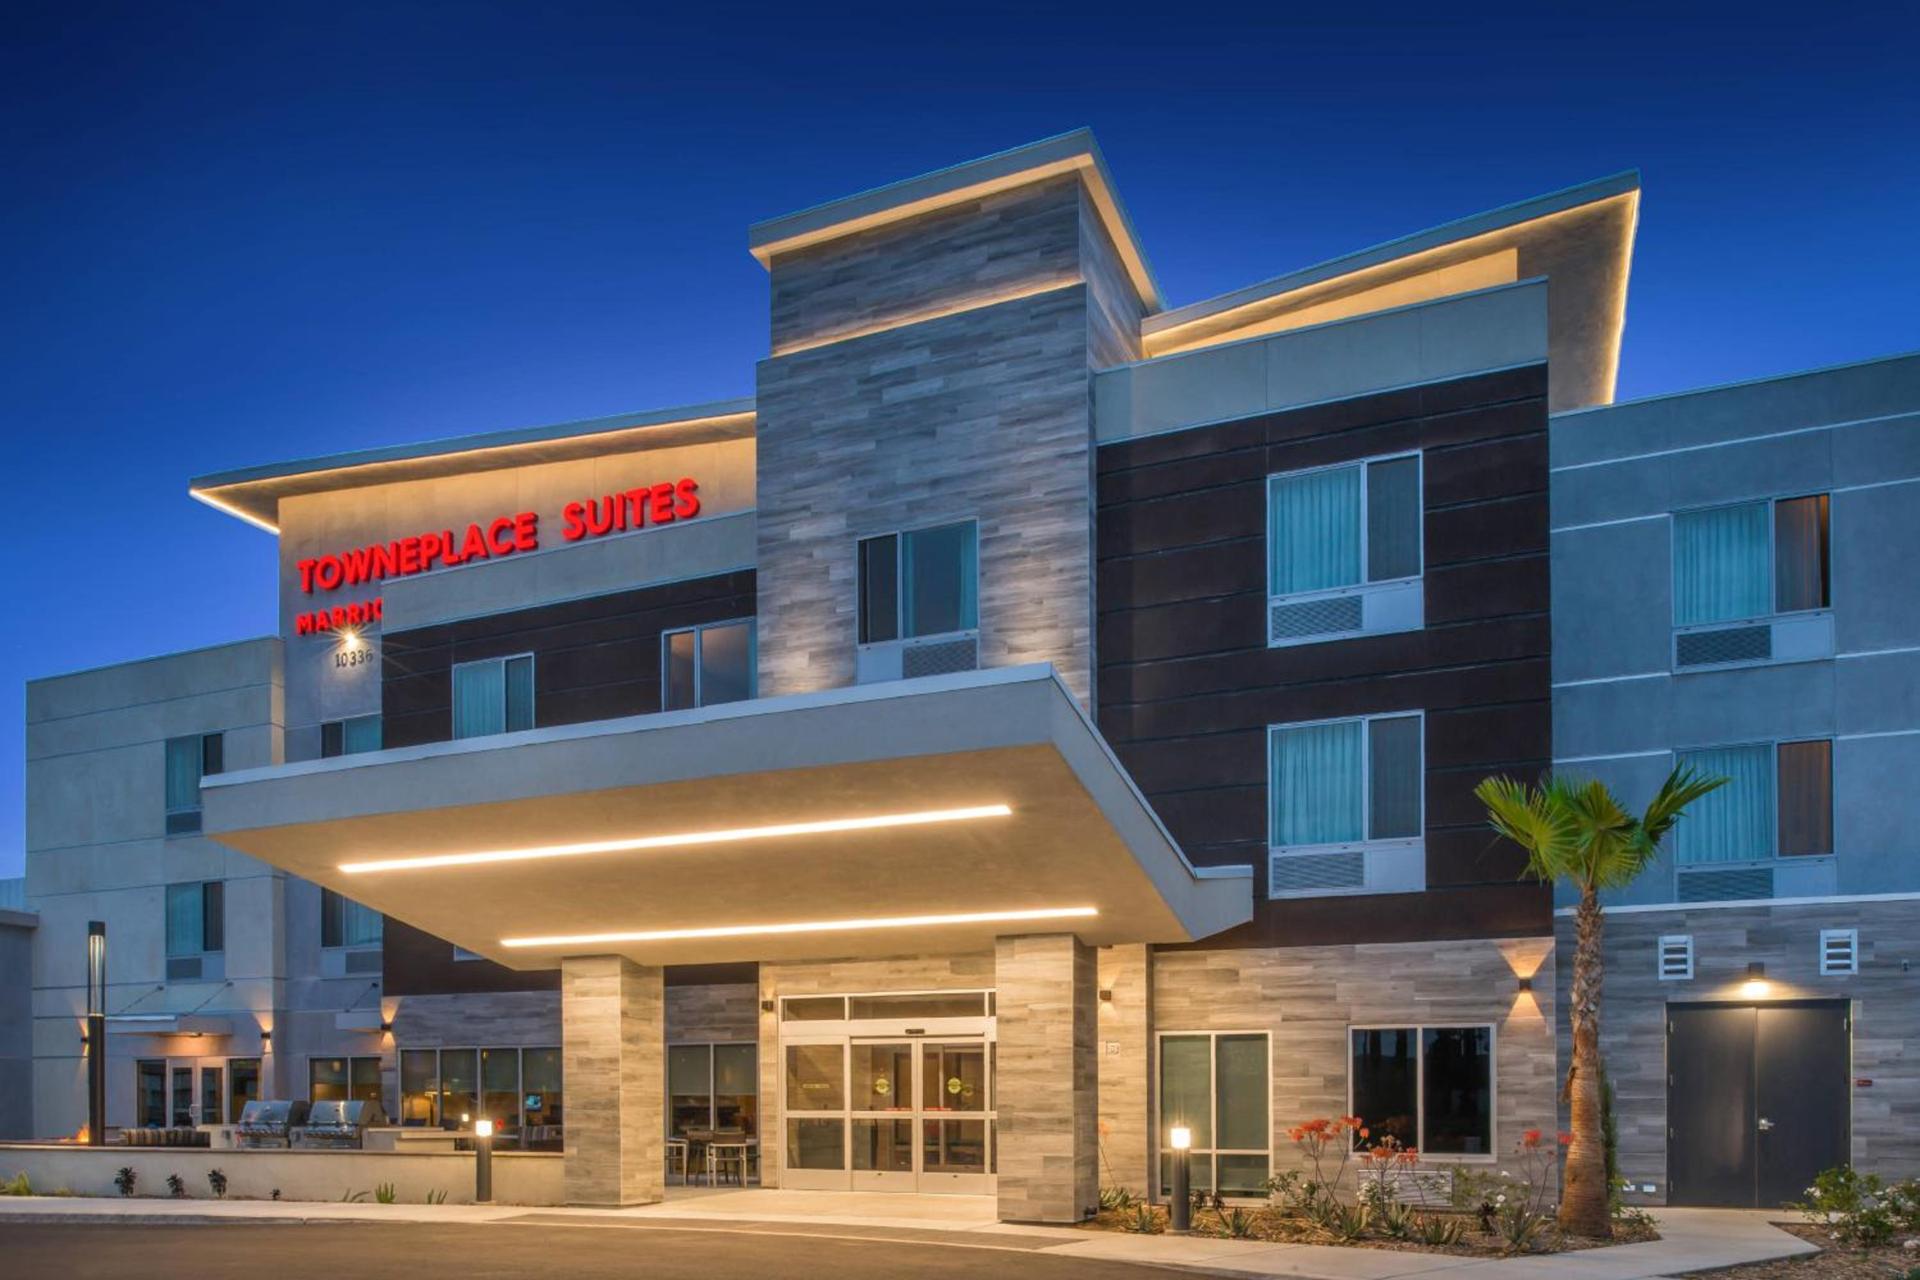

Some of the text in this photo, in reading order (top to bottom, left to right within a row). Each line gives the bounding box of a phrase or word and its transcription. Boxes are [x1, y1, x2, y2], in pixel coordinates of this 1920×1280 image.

[296, 477, 700, 593] TOWNEPLACE SUITES
[335, 649, 374, 668] 10336
